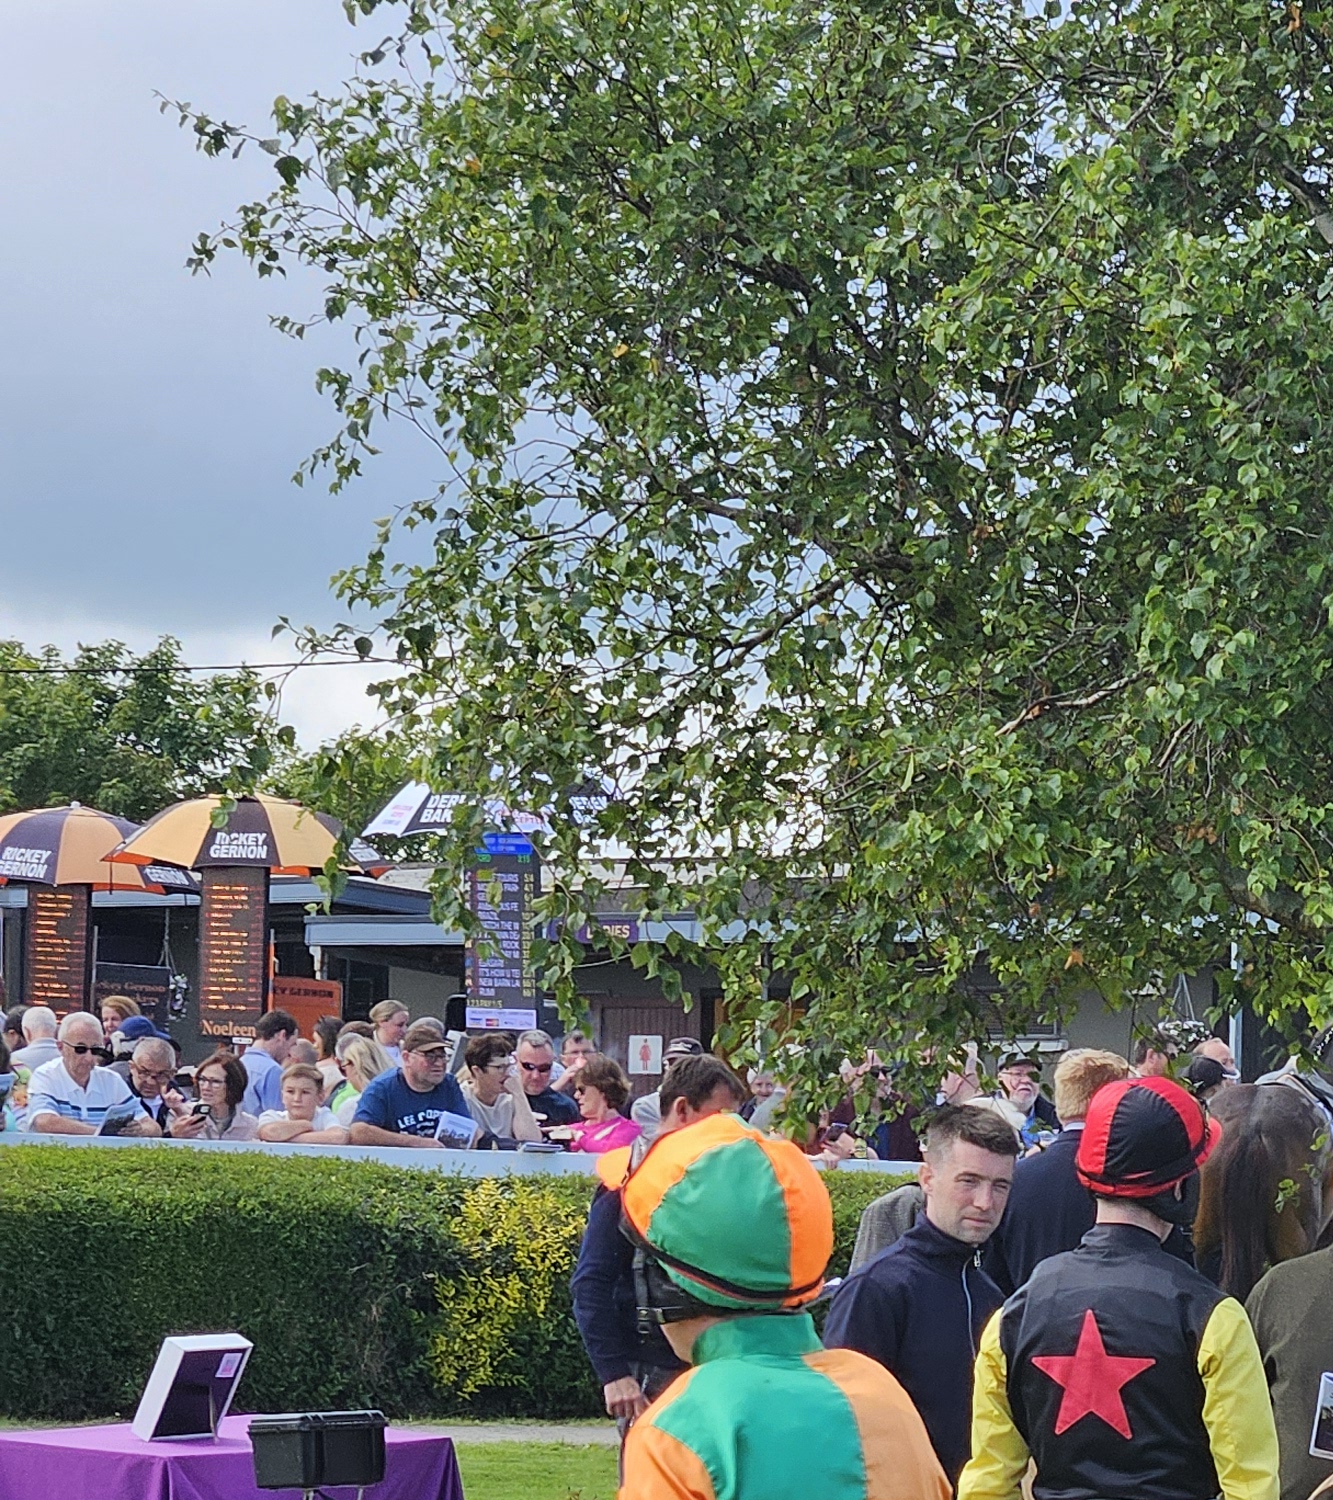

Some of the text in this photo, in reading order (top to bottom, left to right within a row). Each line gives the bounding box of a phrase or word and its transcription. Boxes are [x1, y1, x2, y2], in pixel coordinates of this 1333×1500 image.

[2, 846, 51, 863] RICKEY
[209, 845, 267, 859] GERNON
[586, 925, 630, 939] LDIES
[201, 1019, 256, 1038] Noeleen
